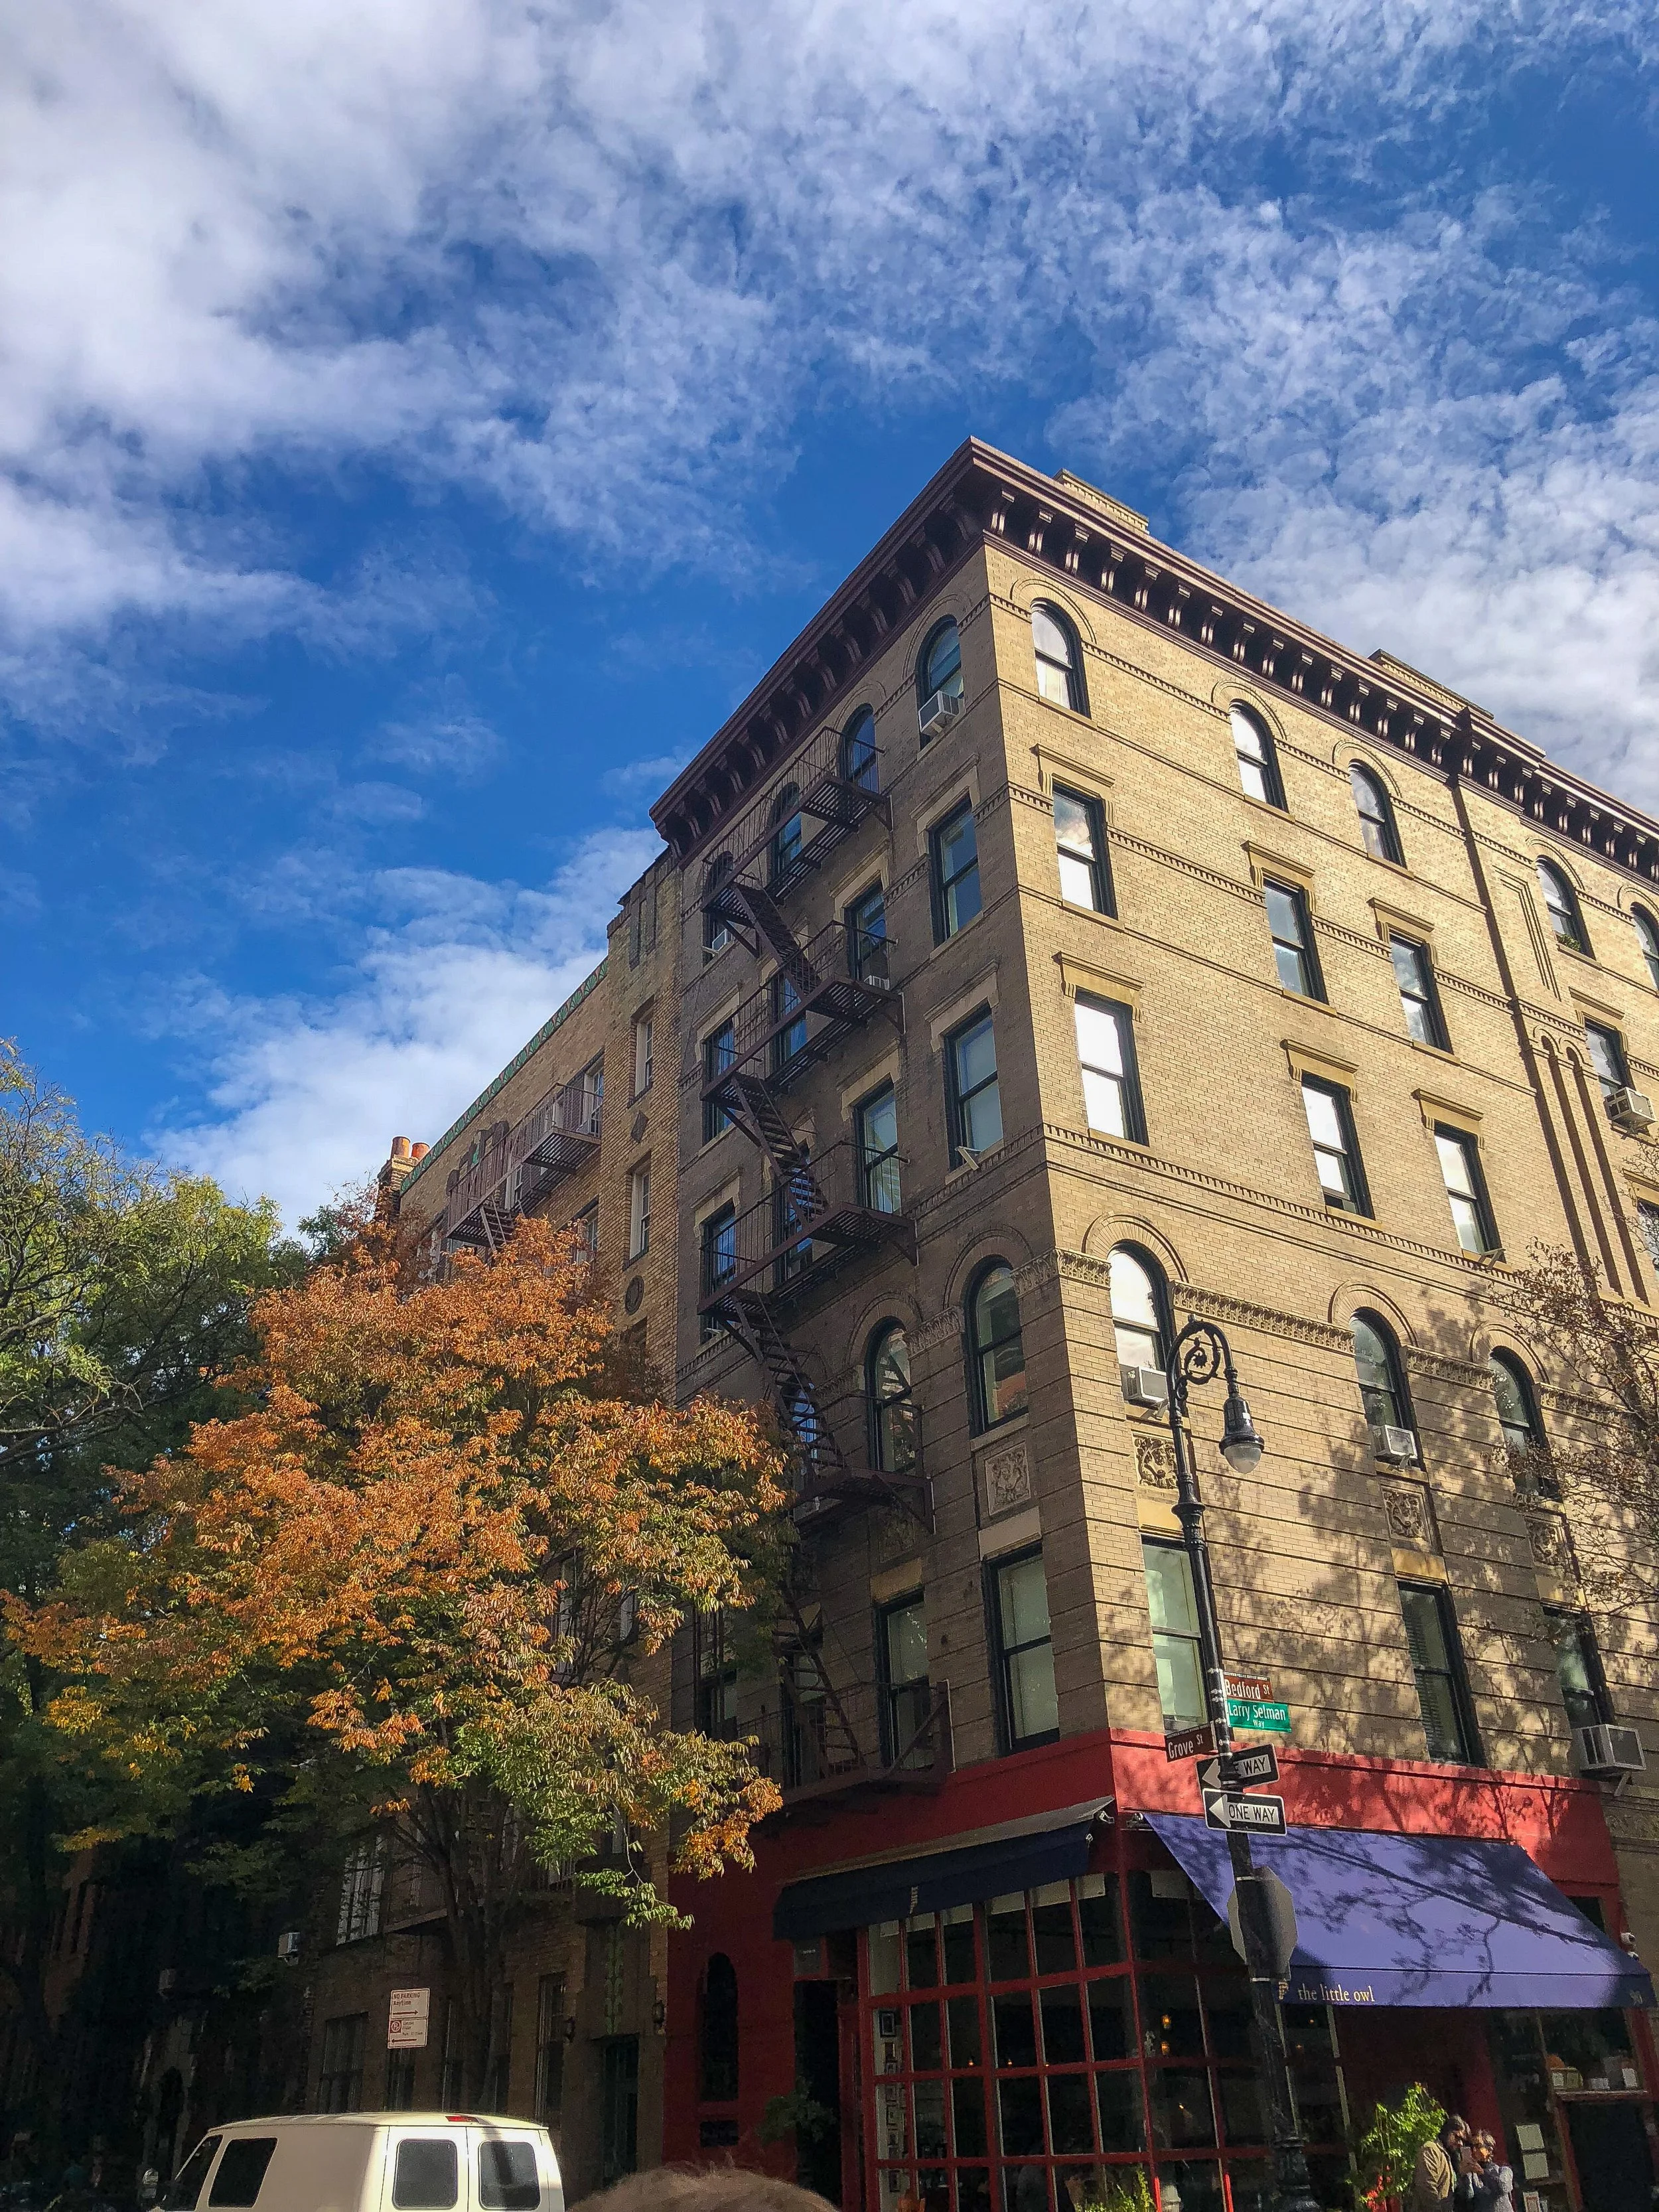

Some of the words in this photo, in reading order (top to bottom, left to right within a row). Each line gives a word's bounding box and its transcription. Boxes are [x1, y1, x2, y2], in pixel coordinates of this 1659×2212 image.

[1224, 1679, 1261, 1700] Bedford
[1262, 1684, 1270, 1695] St
[1228, 1702, 1250, 1722] Larry
[1252, 1704, 1286, 1721] Selman
[1252, 1719, 1265, 1729] Way
[1168, 1740, 1194, 1759] Grove
[1196, 1733, 1204, 1745] St
[1243, 1757, 1266, 1775] WAY
[1228, 1804, 1250, 1820] ONE
[1252, 1806, 1275, 1822] WAY
[1298, 1983, 1317, 2000] the
[1320, 1983, 1350, 2002] little
[1354, 1985, 1375, 2002] owl
